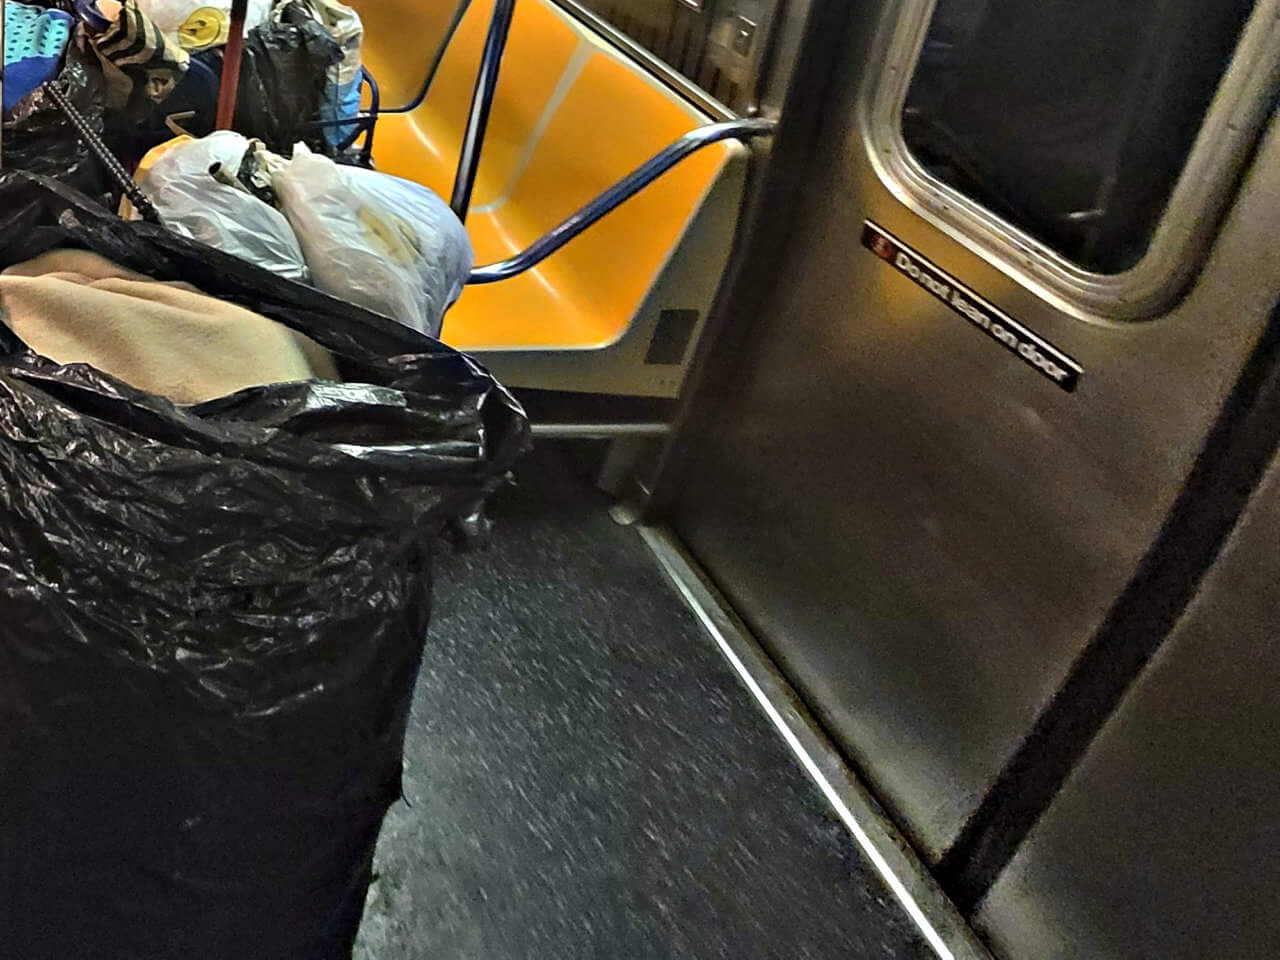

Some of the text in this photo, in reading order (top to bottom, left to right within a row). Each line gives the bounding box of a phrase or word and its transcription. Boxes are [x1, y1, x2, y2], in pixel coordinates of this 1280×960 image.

[896, 251, 1069, 380] Do not lean on door
